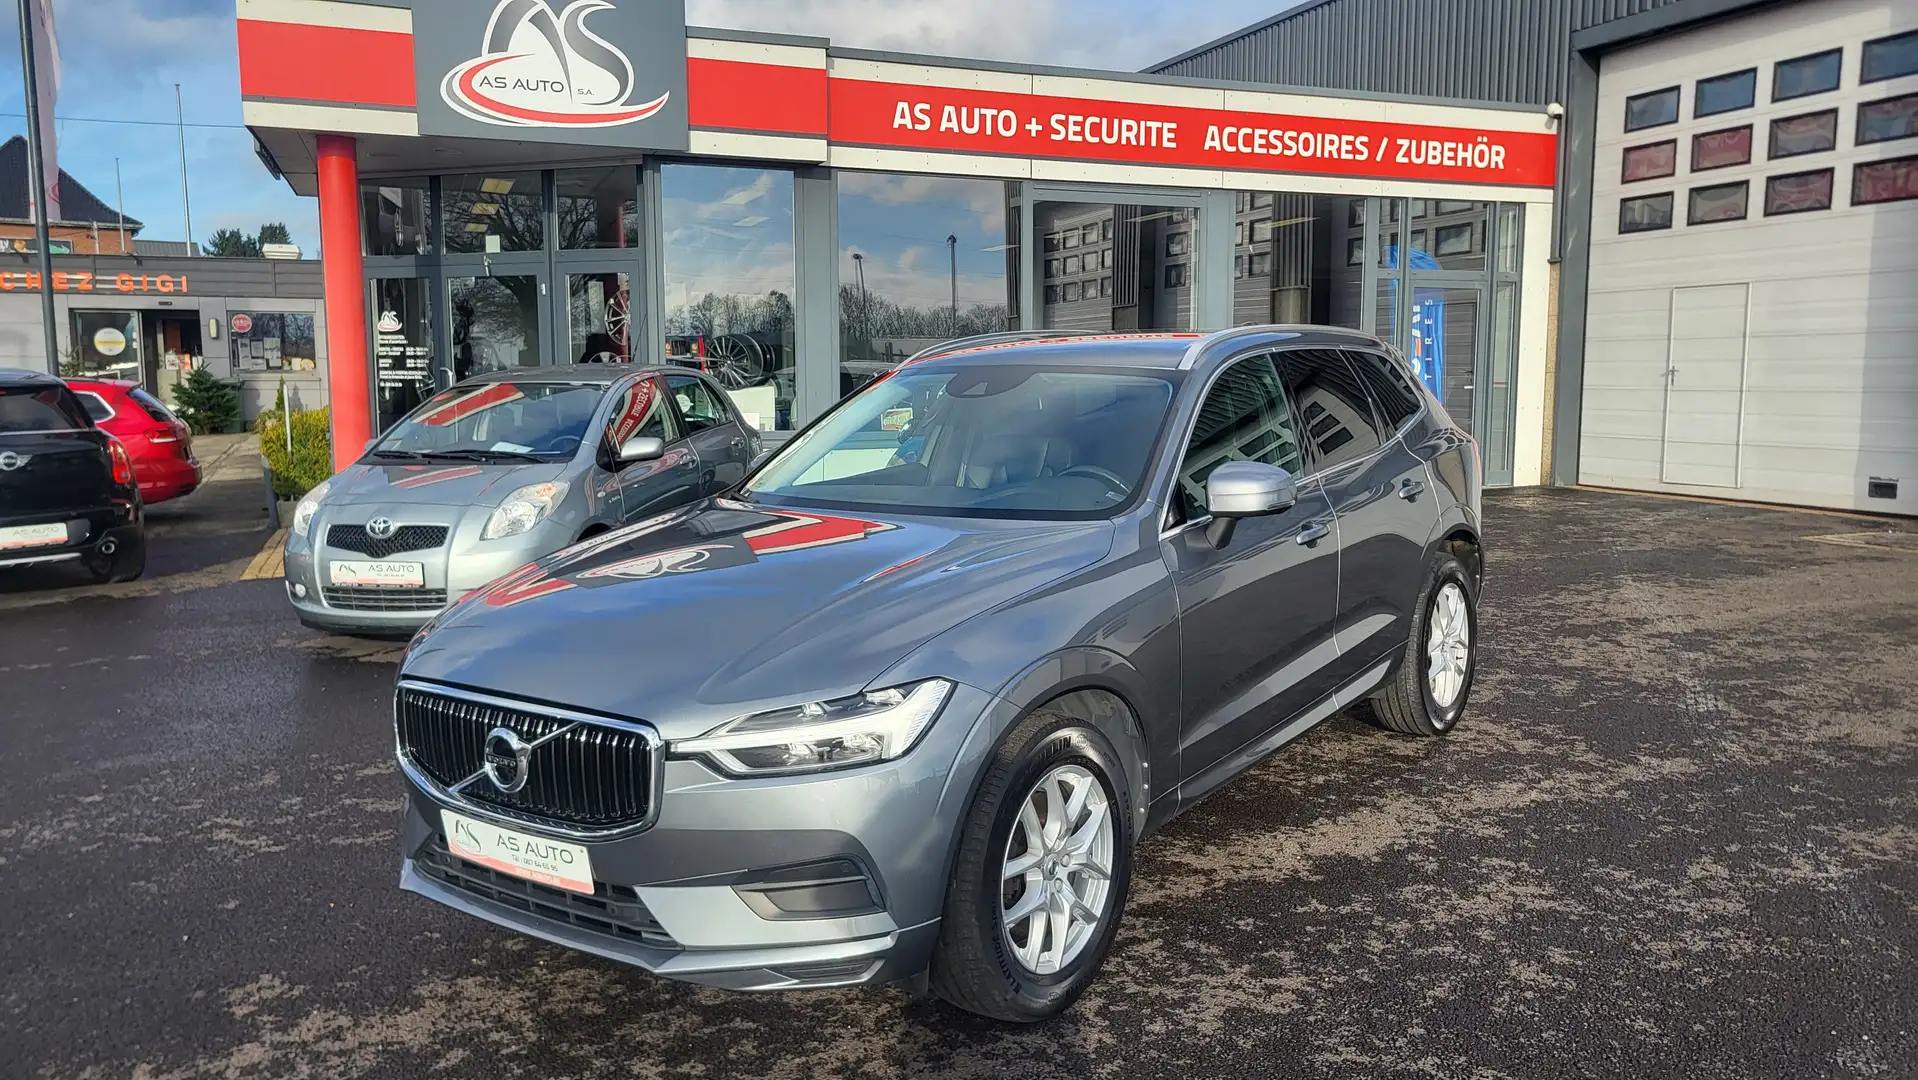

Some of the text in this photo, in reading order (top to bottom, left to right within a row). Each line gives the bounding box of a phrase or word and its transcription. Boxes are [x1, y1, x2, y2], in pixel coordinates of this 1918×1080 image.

[479, 75, 507, 89] AS
[512, 78, 564, 94] AUTO
[892, 101, 1178, 149] AS AUTO + SECURITE
[1203, 125, 1506, 170] ACCESSOIRES / ZUBEHÖR
[0, 271, 188, 294] CHEZ GIGI
[1424, 299, 1432, 380] TIRES
[497, 833, 573, 864] AS AUTO
